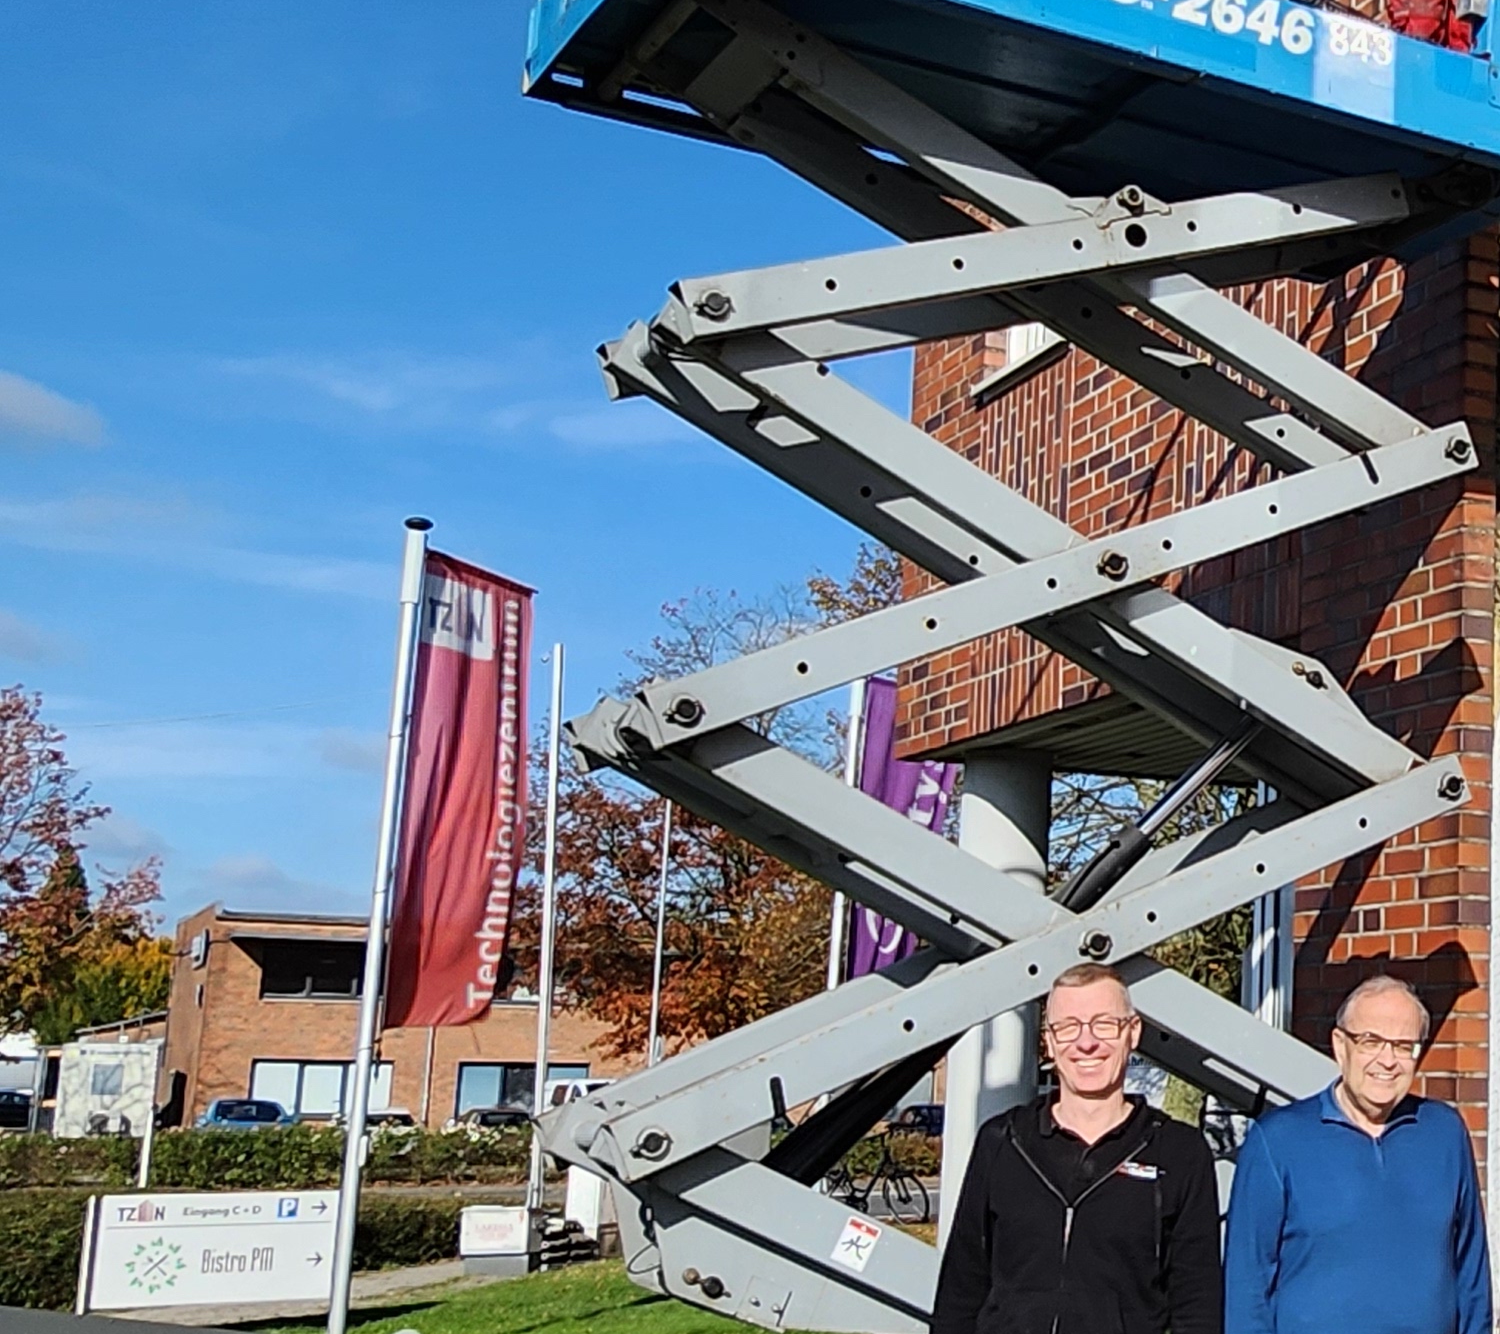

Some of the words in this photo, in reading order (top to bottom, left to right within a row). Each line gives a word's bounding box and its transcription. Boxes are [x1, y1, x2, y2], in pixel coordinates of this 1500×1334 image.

[1328, 19, 1393, 67] 843
[182, 1206, 230, 1219] Eingang
[252, 1205, 262, 1215] D
[201, 1248, 247, 1274] Bistro
[250, 1246, 274, 1272] PM
